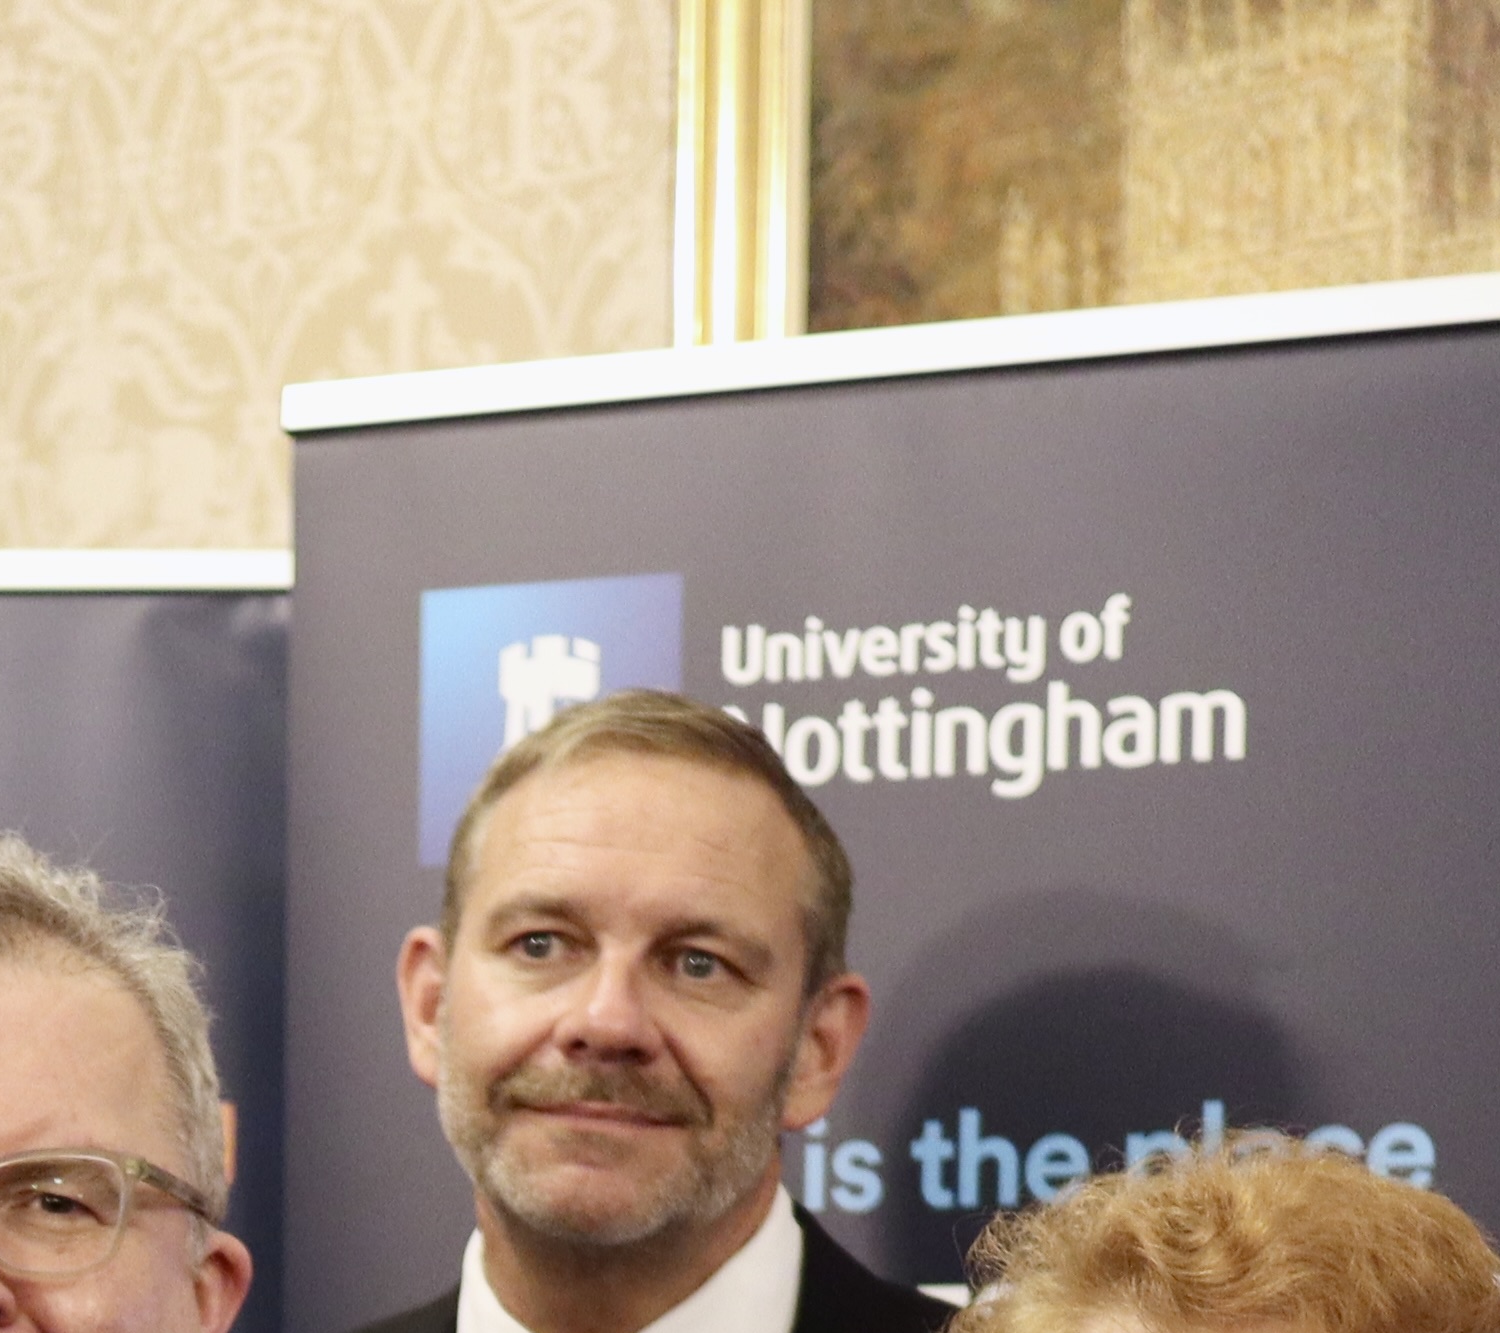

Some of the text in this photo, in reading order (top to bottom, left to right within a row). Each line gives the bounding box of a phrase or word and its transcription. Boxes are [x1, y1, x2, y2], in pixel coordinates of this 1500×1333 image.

[721, 593, 1132, 682] University of
[803, 1117, 884, 1213] is
[910, 1109, 1090, 1208] the
